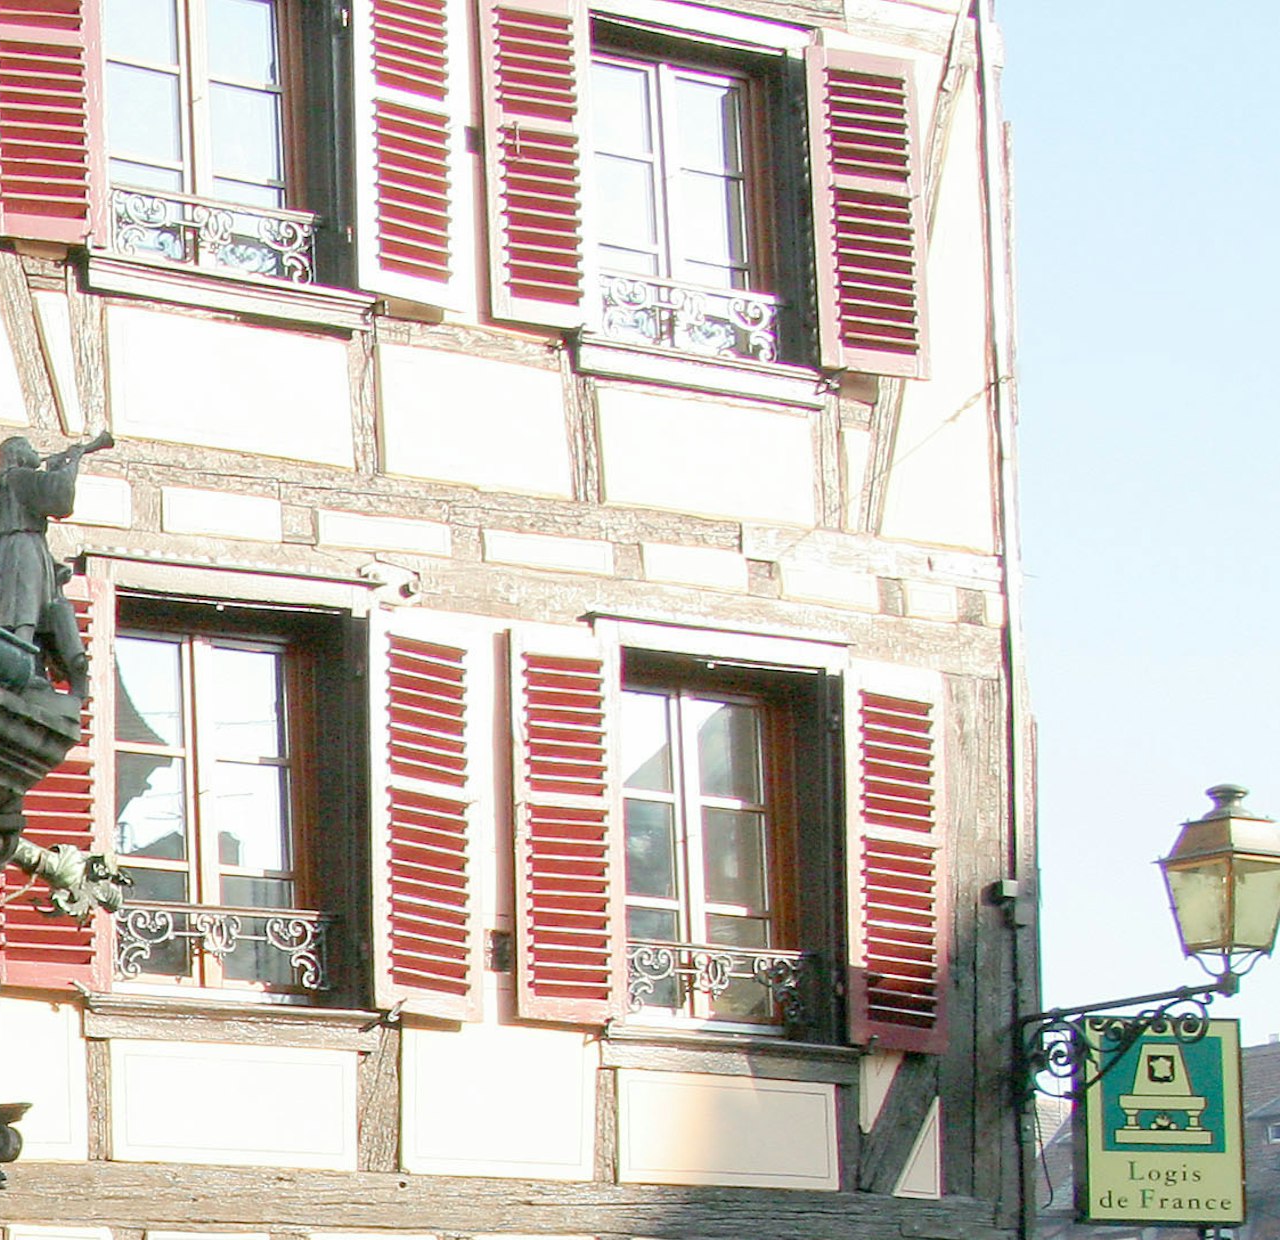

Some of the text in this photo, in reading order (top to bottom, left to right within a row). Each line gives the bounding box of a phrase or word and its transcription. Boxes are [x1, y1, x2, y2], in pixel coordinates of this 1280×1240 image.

[1128, 1161, 1202, 1186] Logis
[1099, 1188, 1233, 1211] de France
